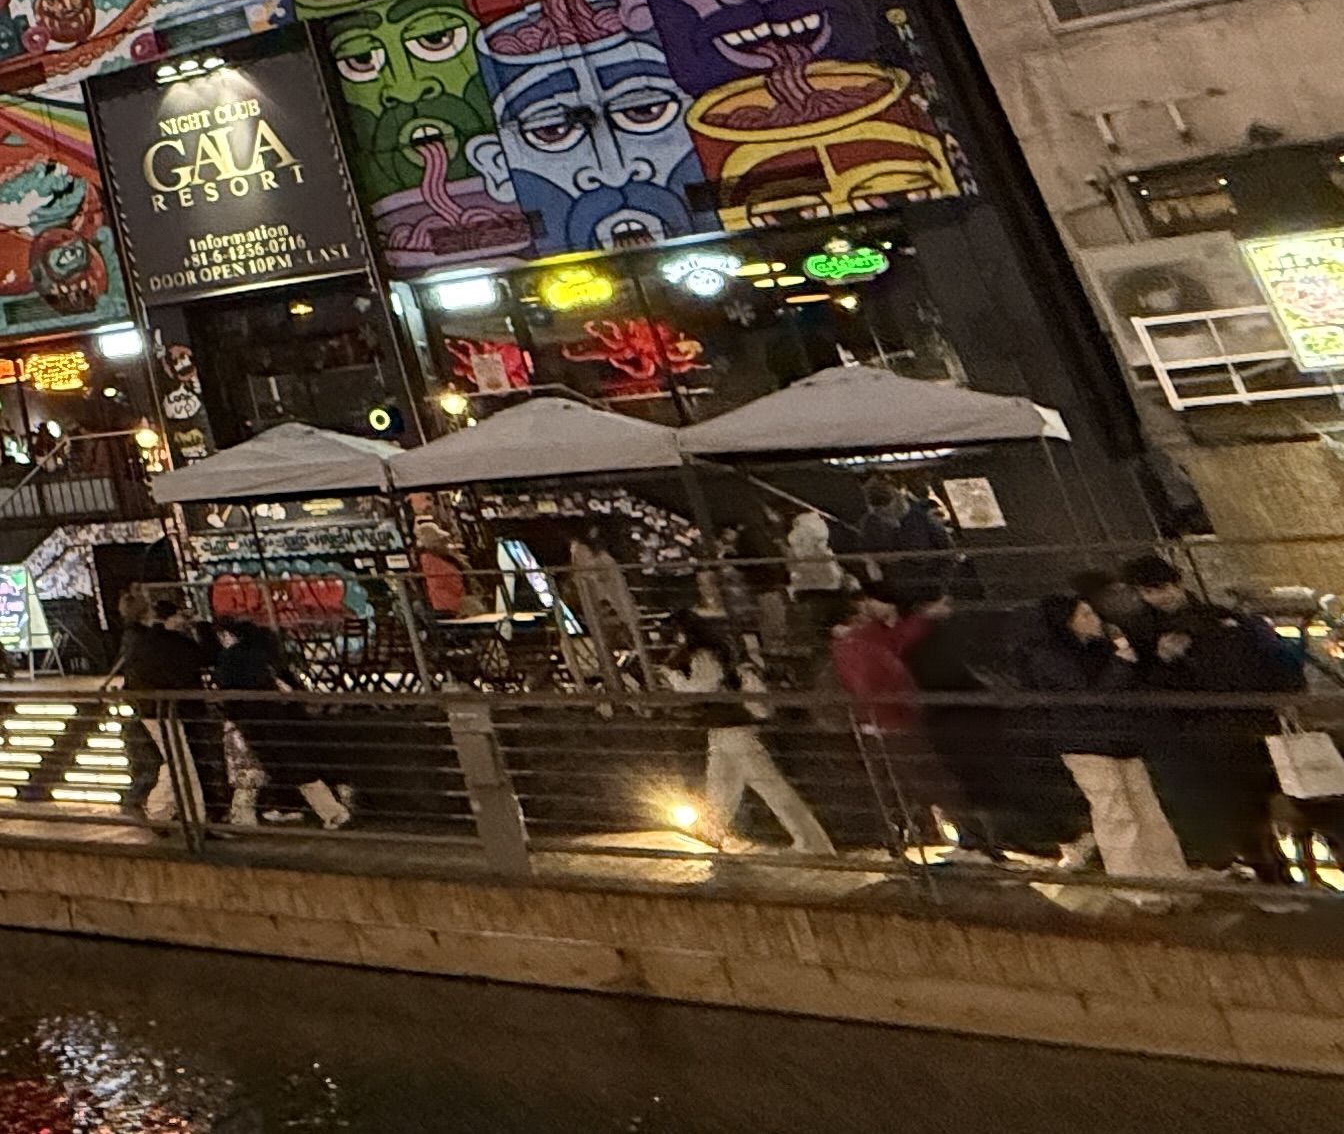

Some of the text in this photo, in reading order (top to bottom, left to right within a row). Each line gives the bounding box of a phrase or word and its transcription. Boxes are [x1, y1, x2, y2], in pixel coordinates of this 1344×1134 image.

[158, 99, 262, 136] NIGHT CLUB
[143, 120, 300, 193] GALA
[152, 165, 305, 213] RESORT
[188, 224, 290, 253] Information
[149, 269, 198, 292] DOOR
[200, 262, 247, 284] OPEN
[249, 253, 293, 275] 10PM
[307, 244, 351, 265] LAST
